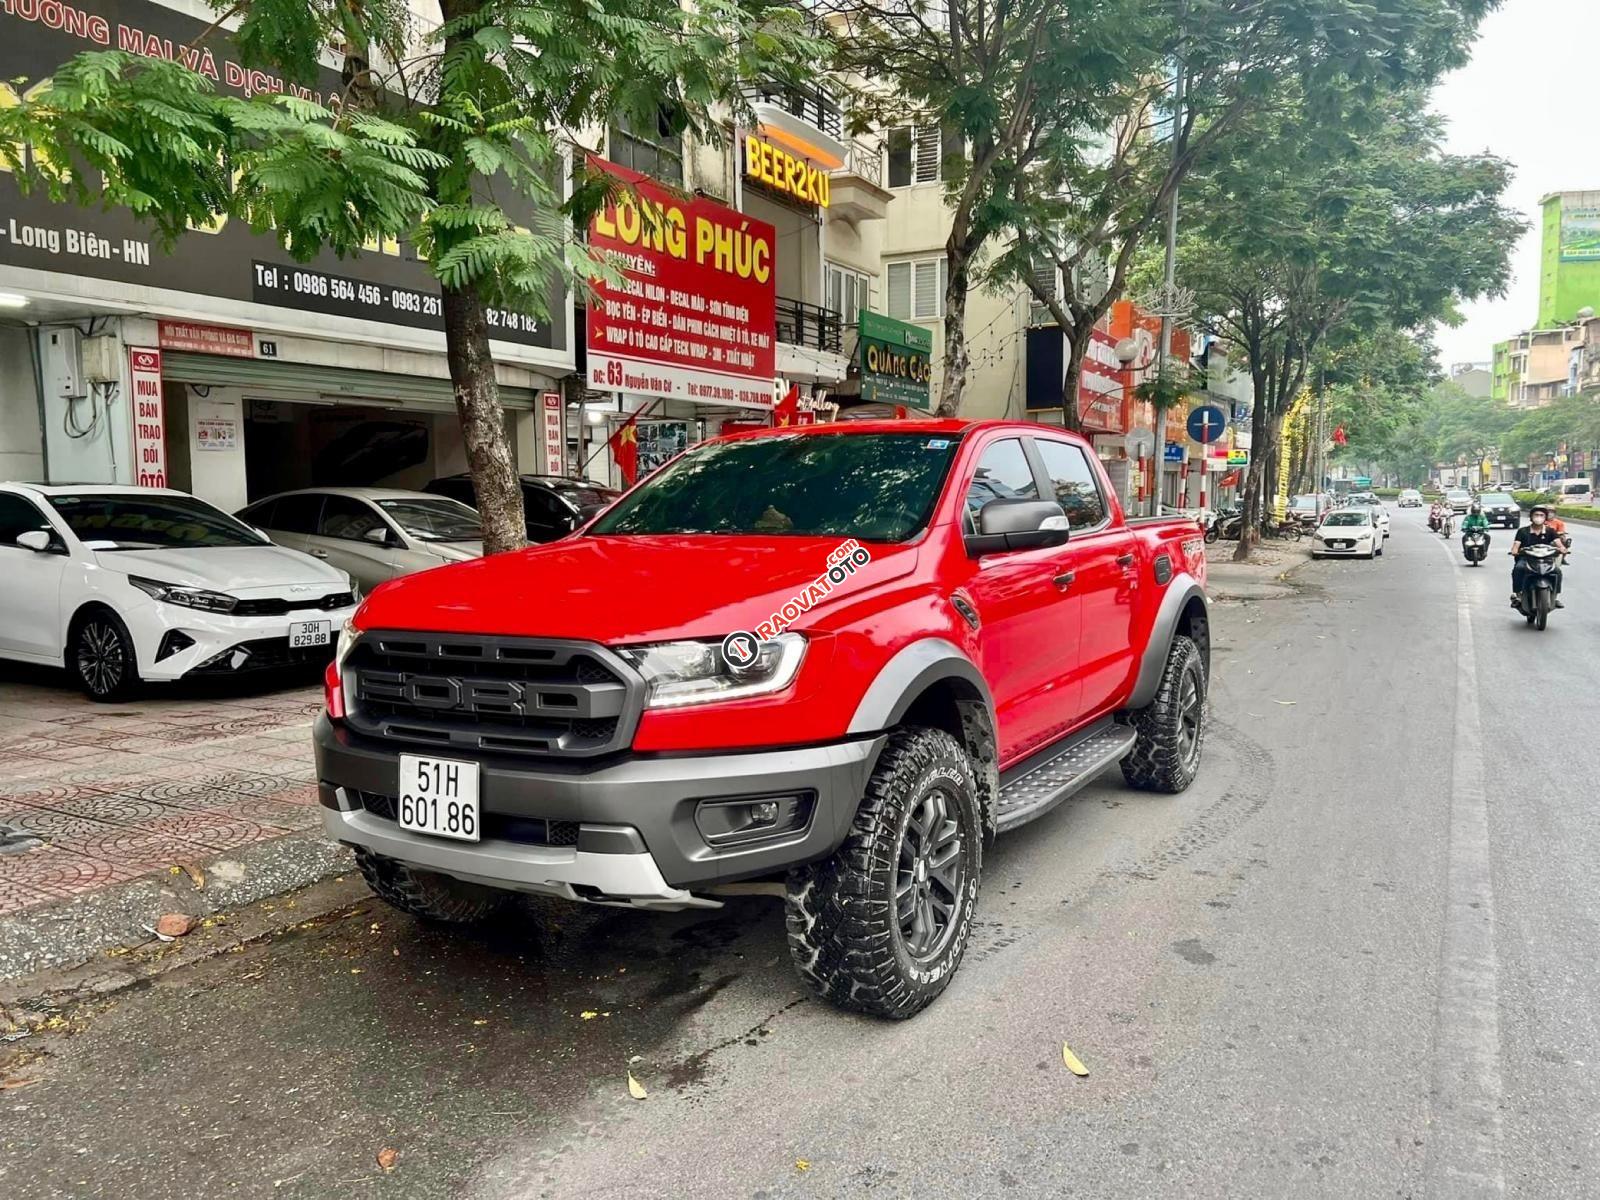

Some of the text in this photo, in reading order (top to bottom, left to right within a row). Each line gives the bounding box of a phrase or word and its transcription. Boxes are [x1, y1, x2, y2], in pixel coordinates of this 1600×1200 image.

[179, 44, 220, 81] VÀ
[745, 134, 829, 208] BEER2KU
[10, 218, 60, 254] Long
[66, 228, 110, 259] Biên
[123, 239, 150, 266] HN
[596, 195, 770, 284] LONG PHÚC
[293, 271, 328, 297] 0986
[330, 277, 355, 302] 564
[358, 284, 381, 306] 456
[392, 289, 420, 312] 0983
[423, 295, 443, 317] 261
[501, 310, 519, 330] 748
[606, 325, 628, 346] WRAP
[262, 343, 274, 355] 61
[606, 361, 623, 387] 63
[137, 380, 158, 397] MUA
[139, 398, 158, 418] BÁN
[138, 423, 161, 440] TRAO
[143, 442, 159, 464] ĐỔI
[294, 633, 327, 646] 829.88
[301, 622, 320, 634] 30H
[357, 669, 592, 718] FORD
[418, 761, 459, 798] 51H
[402, 794, 475, 835] 601.86
